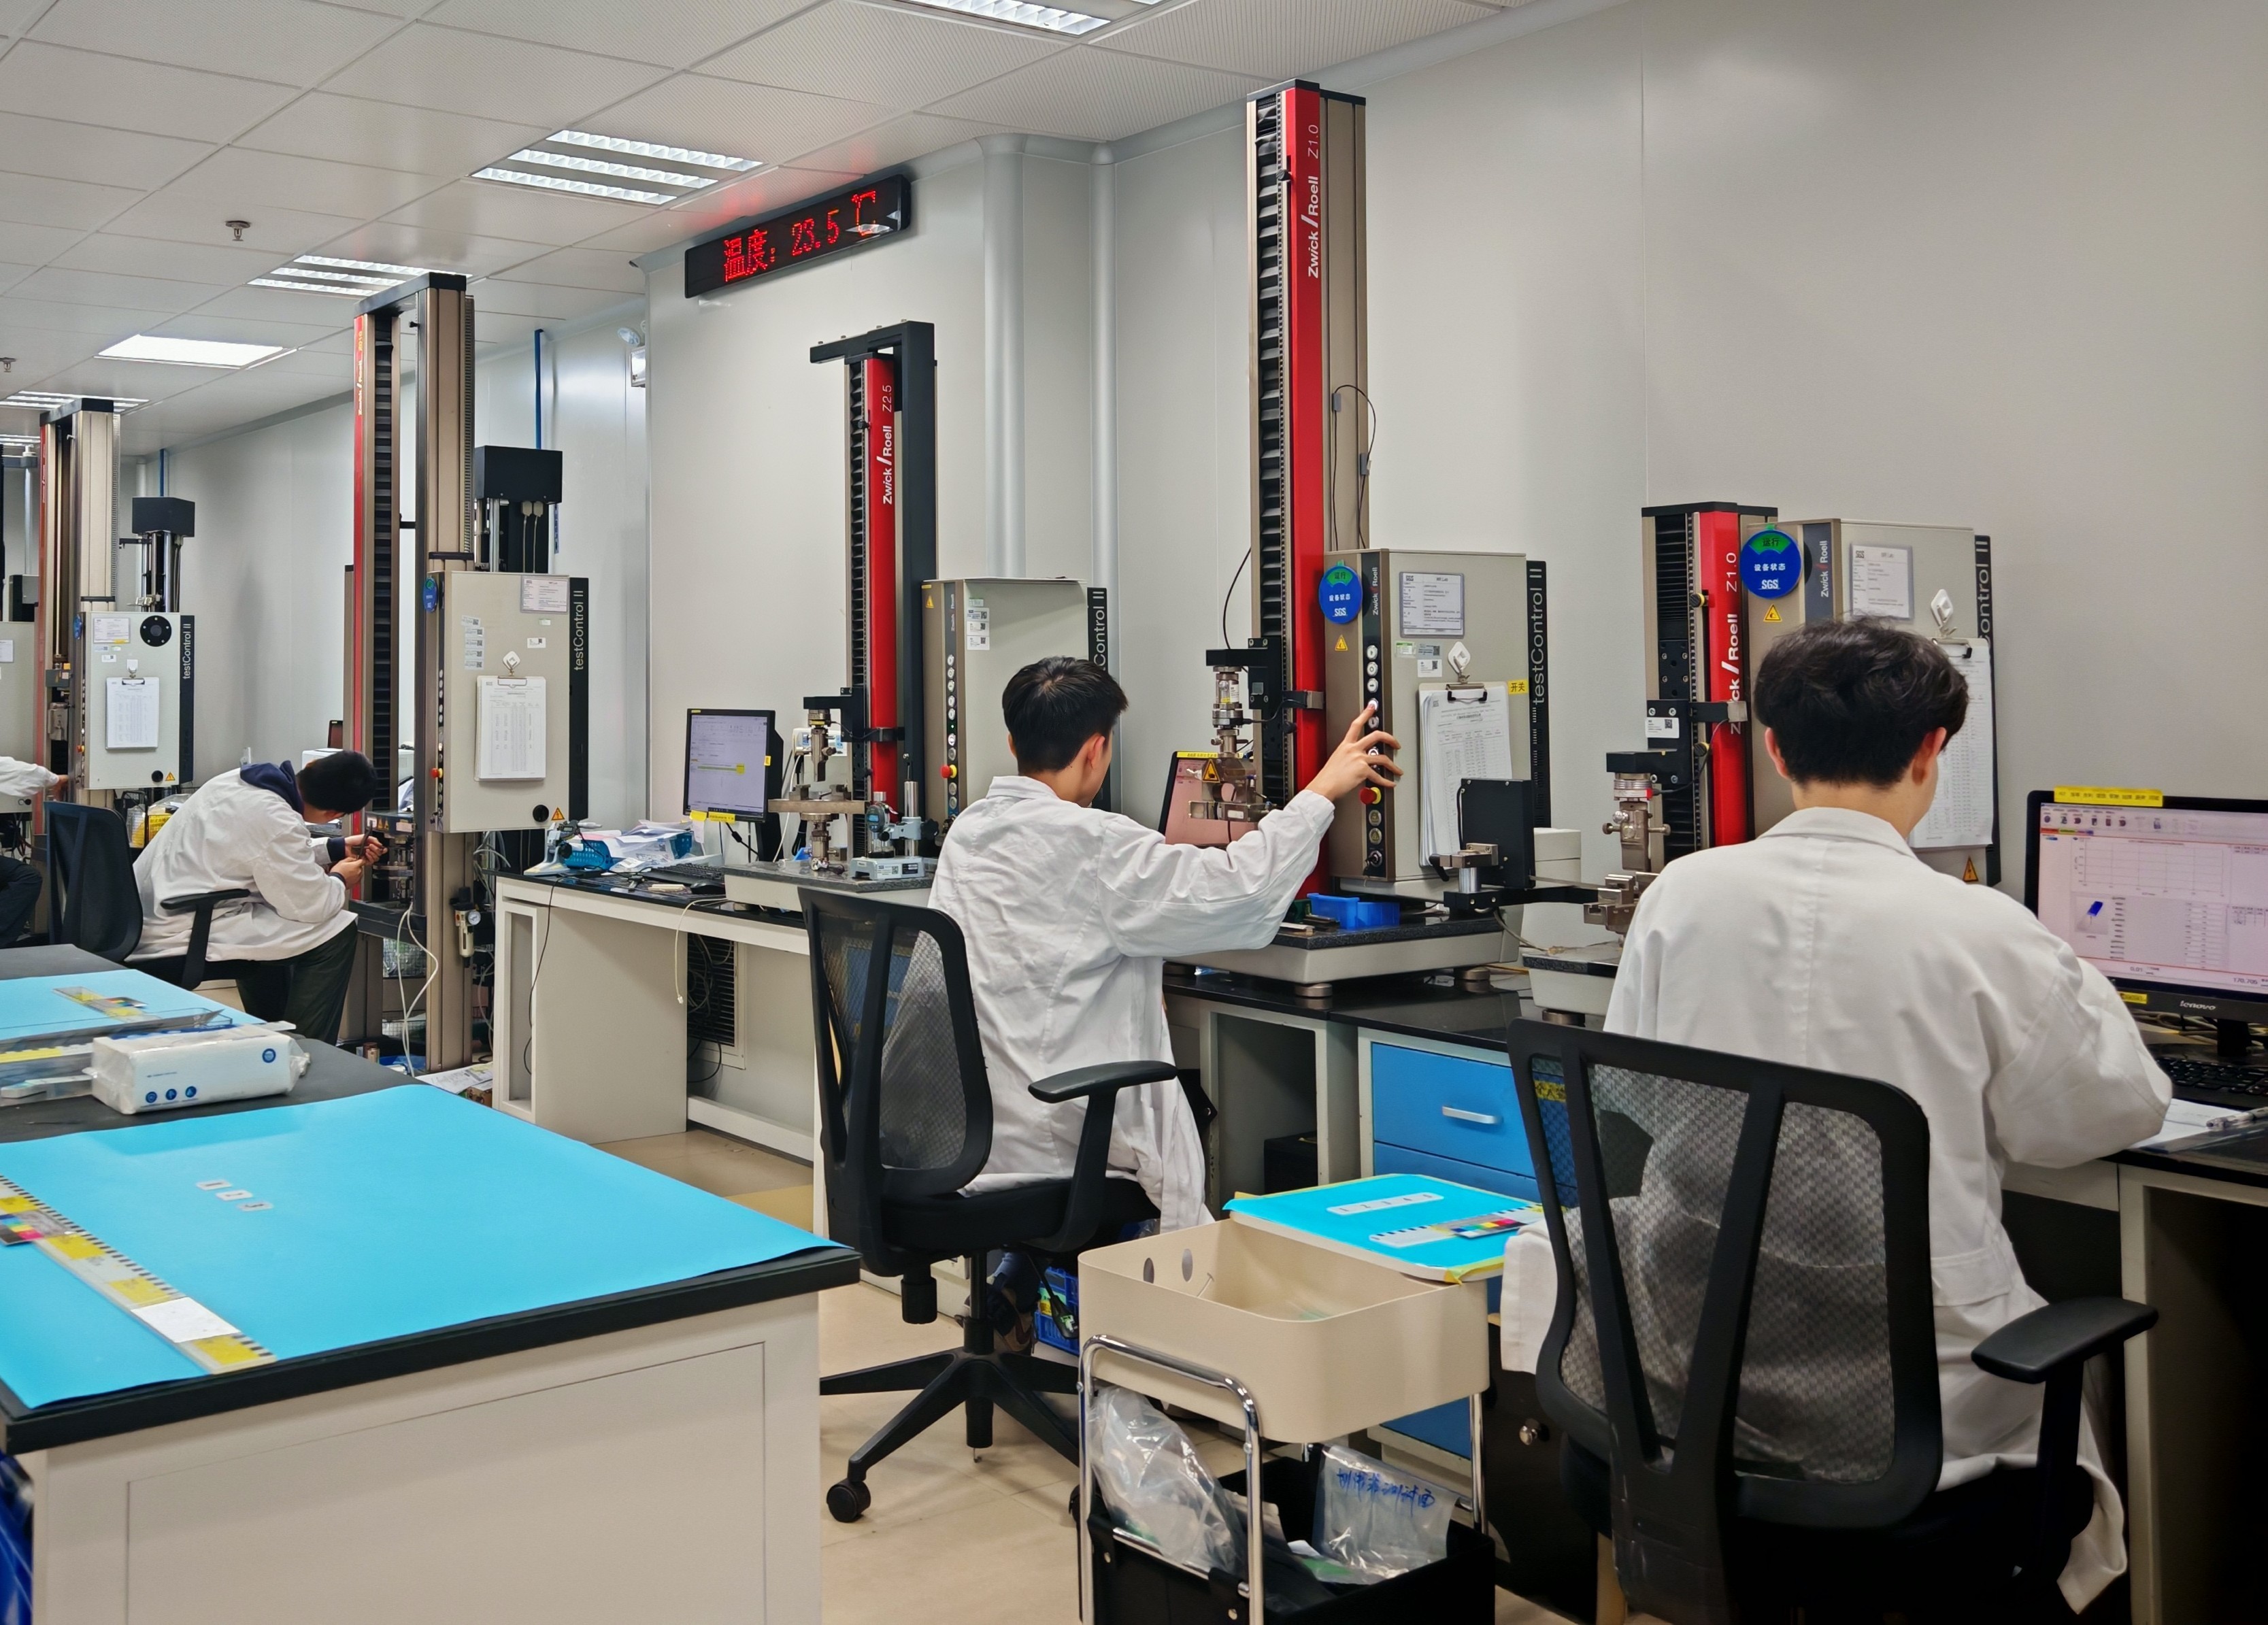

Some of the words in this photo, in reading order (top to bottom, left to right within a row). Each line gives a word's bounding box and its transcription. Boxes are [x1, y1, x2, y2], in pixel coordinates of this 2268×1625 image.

[1307, 124, 1318, 159] Z1.0
[792, 209, 840, 256] 23.5
[882, 385, 893, 413] Z2.5
[1726, 552, 1737, 592] Z1.0
[1754, 563, 1786, 571] 设备状态
[1761, 578, 1779, 590] SGS
[1334, 607, 1346, 616] SGS
[573, 602, 584, 671] testControl
[1529, 588, 1545, 705] testControl
[182, 631, 191, 680] testControl
[1511, 682, 1525, 692] 开关
[2179, 1001, 2216, 1010] lenovo
